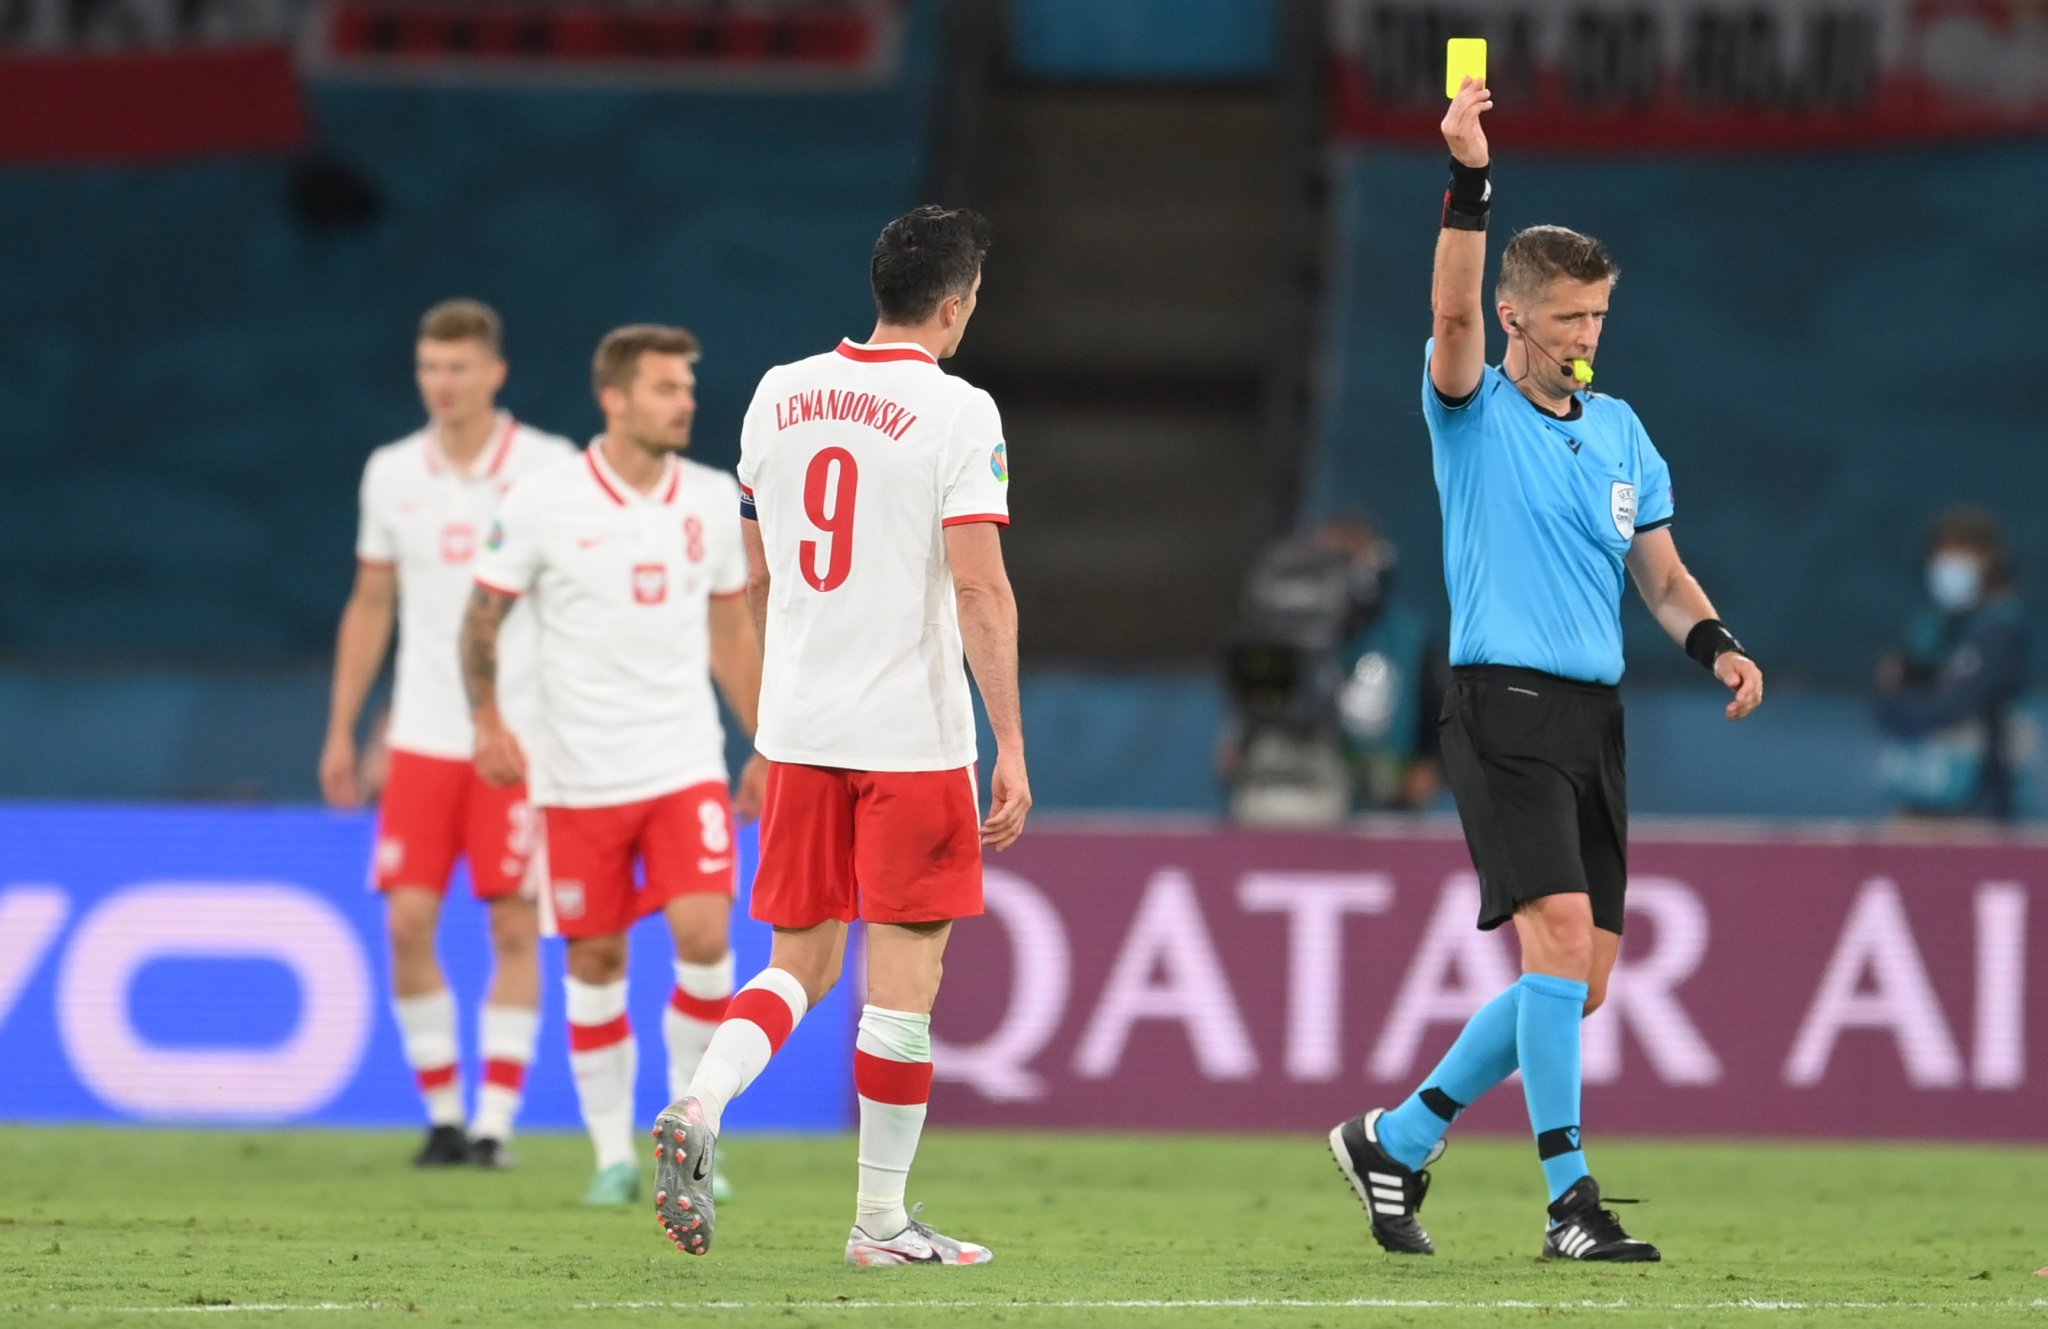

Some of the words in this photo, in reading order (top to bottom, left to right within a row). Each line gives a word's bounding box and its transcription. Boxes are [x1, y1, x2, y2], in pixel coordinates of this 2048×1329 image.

[775, 388, 918, 442] LEWANDOWSKI
[683, 514, 704, 564] 8
[799, 445, 859, 593] 9
[697, 798, 730, 853] 8
[1785, 875, 2030, 1089] AI
